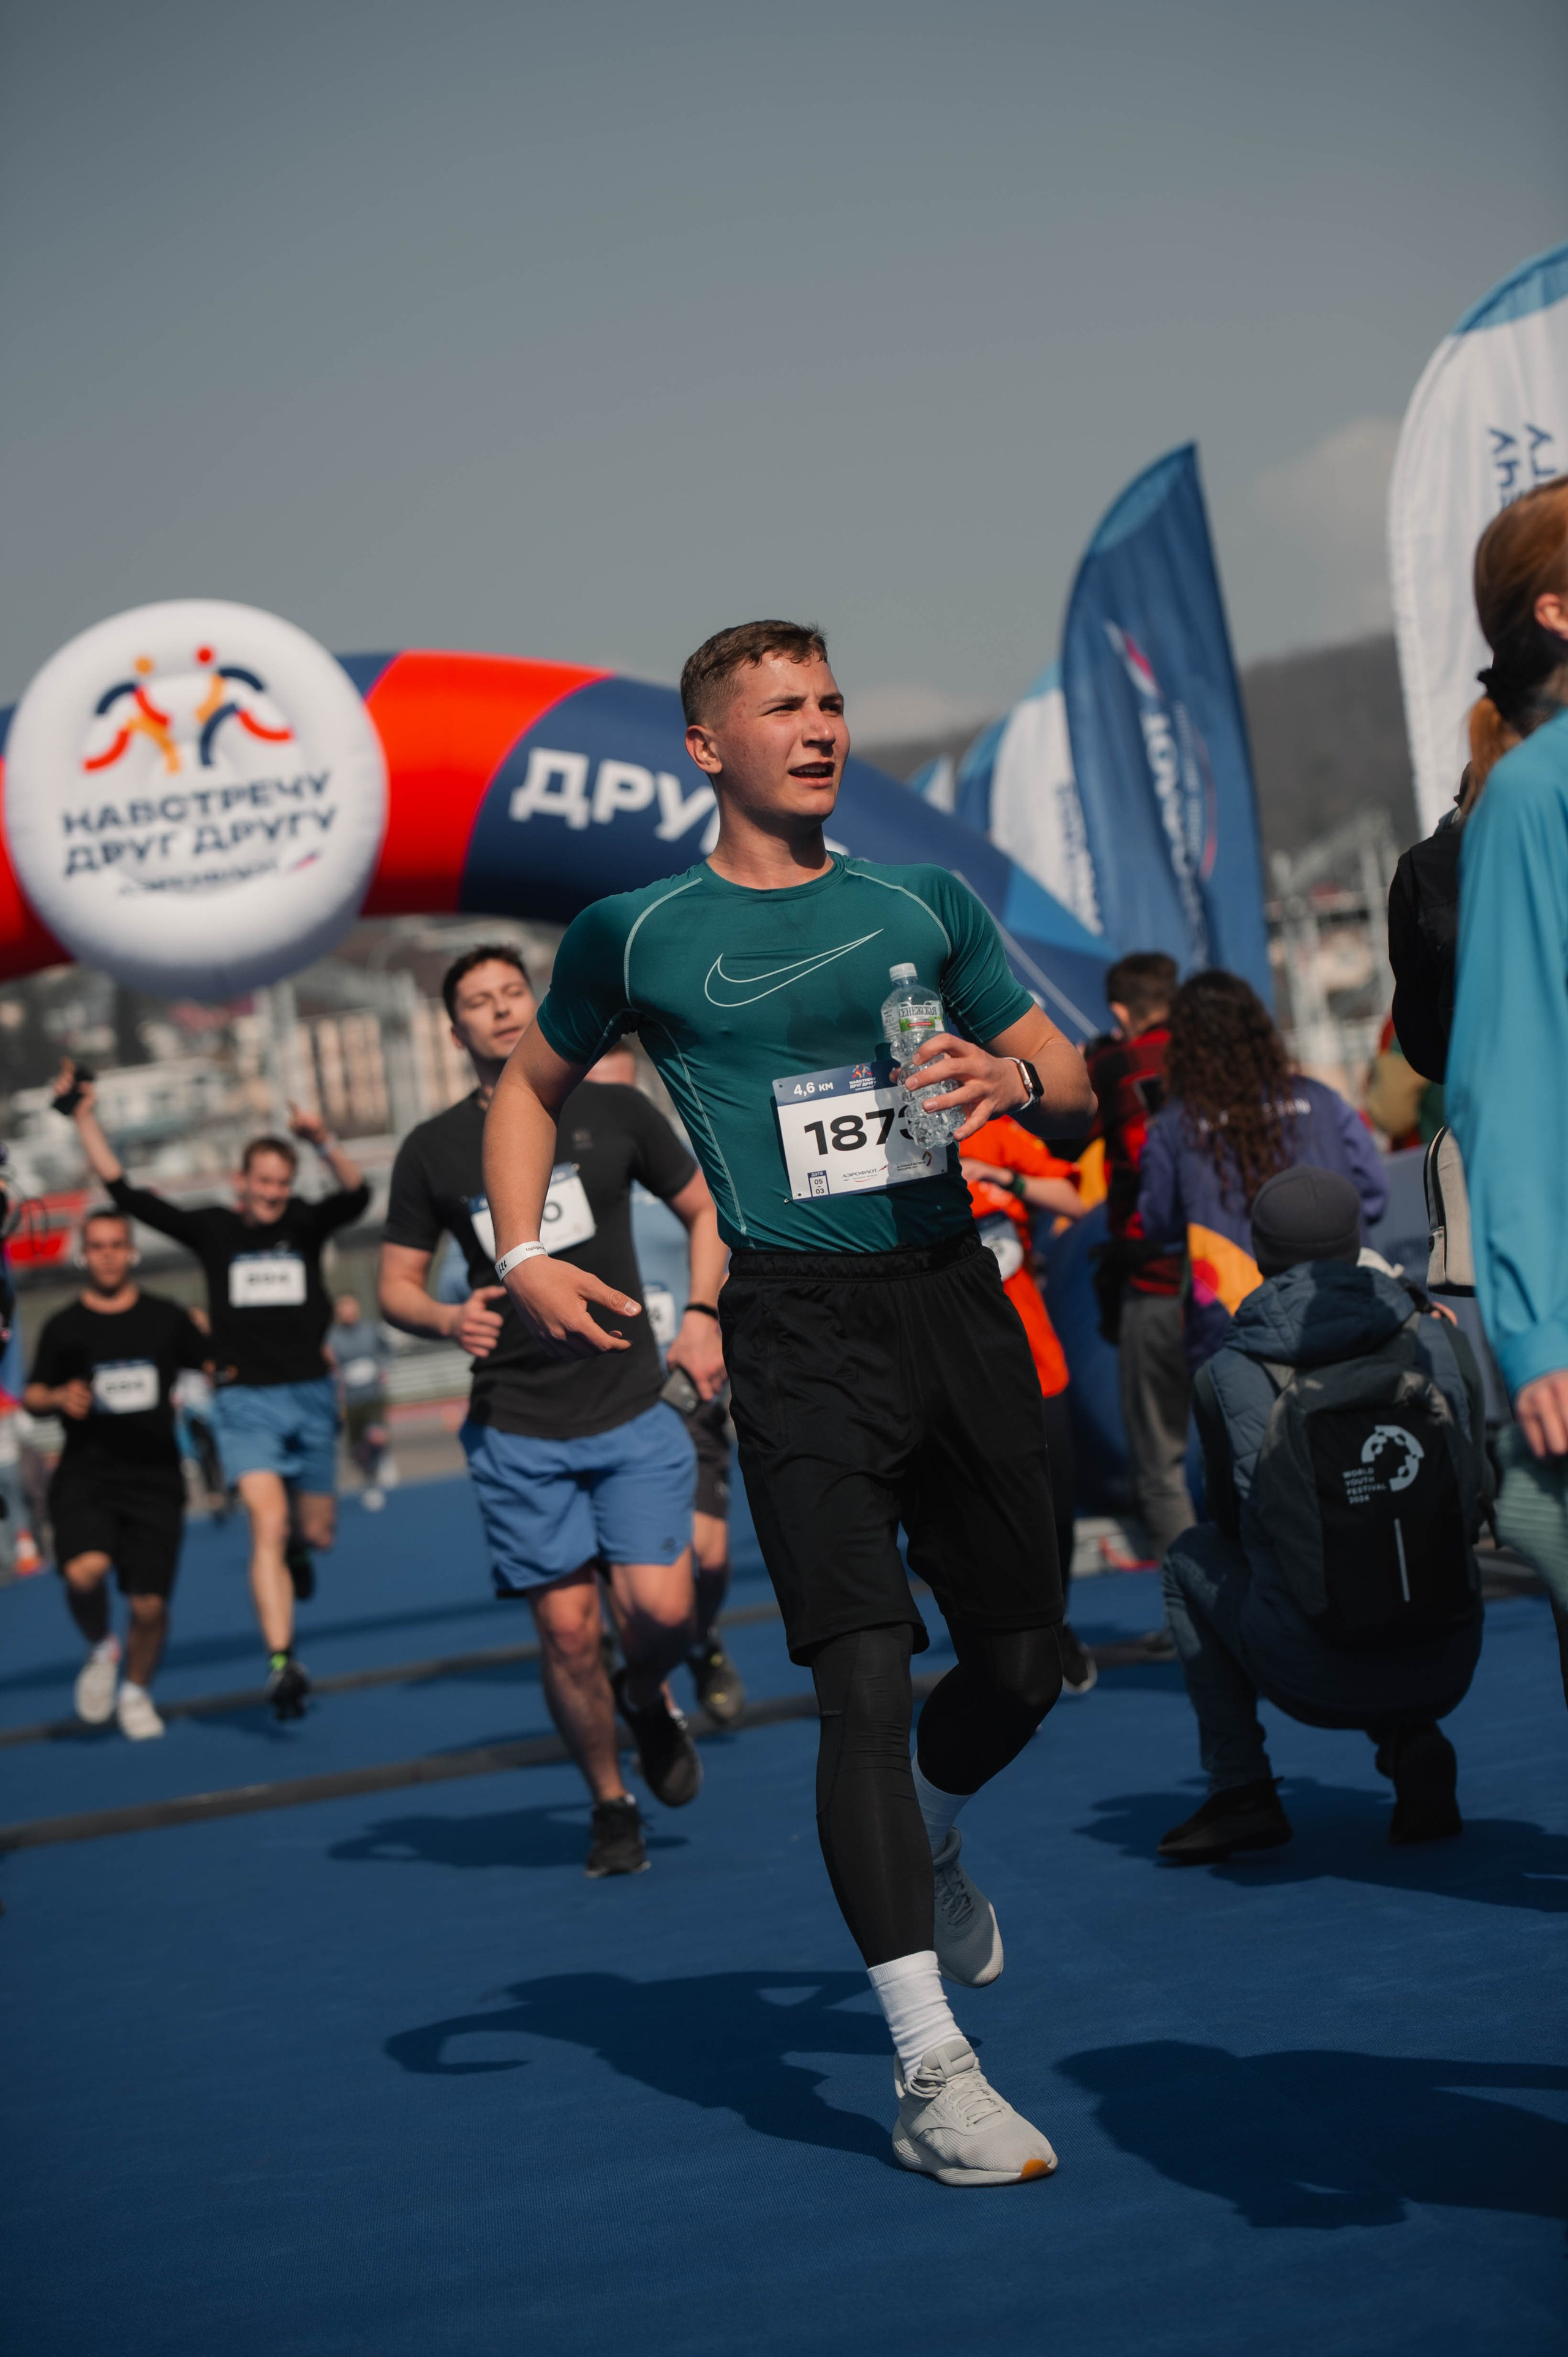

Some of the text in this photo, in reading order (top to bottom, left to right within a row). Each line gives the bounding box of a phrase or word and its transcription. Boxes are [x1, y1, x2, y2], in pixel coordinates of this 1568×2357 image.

[64, 771, 330, 833] НАВСТРЕЧУ
[64, 806, 336, 877] ДРУГ ДРУГУ
[899, 1006, 937, 1017] СЕНЕЖСКАЯ
[794, 1082, 815, 1096] 4,6
[842, 1168, 877, 1178] АЭРОФЛОТ
[1343, 1467, 1374, 1478] WORLD
[1346, 1476, 1374, 1487] YOUTH
[1347, 1483, 1388, 1496] FESTIVAL
